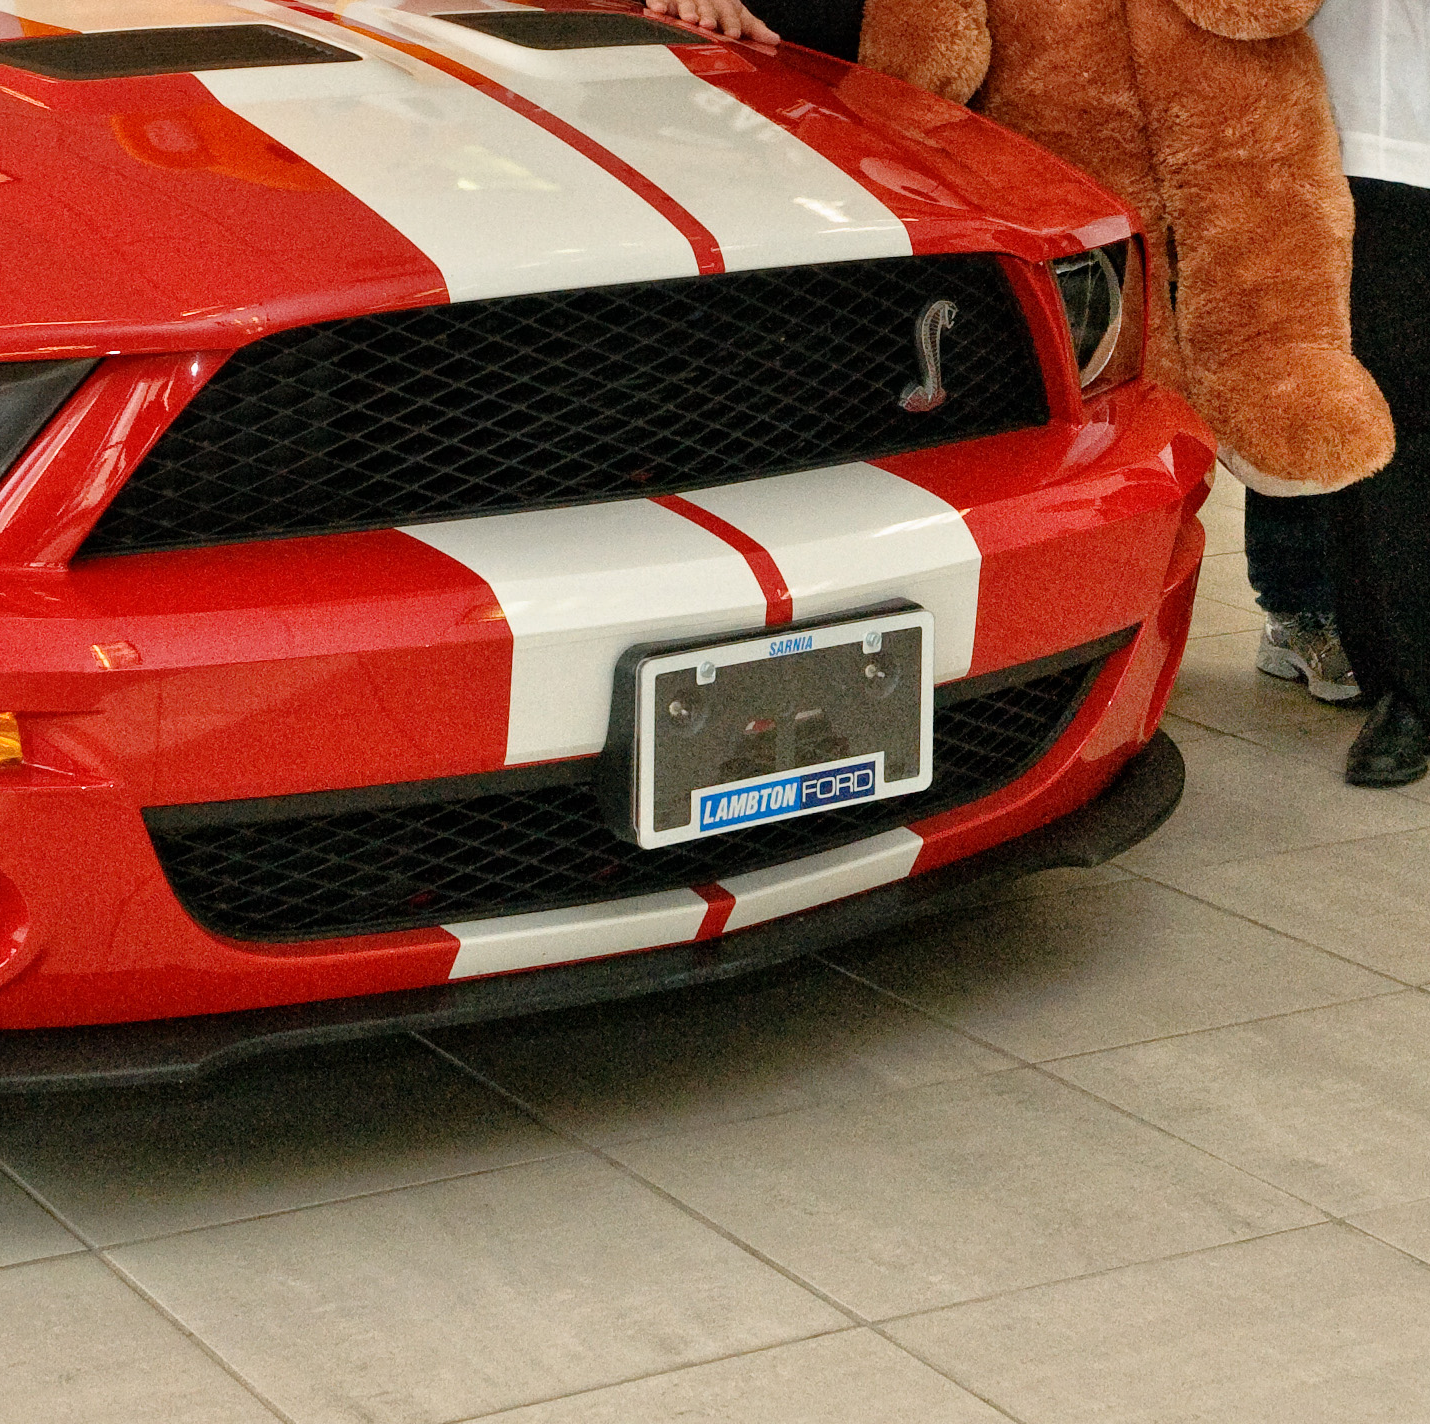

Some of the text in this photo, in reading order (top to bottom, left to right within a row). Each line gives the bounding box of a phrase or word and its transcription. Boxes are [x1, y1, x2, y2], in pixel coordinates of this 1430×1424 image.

[769, 635, 813, 657] SARNIA
[702, 769, 873, 825] LAMBTON FORD
